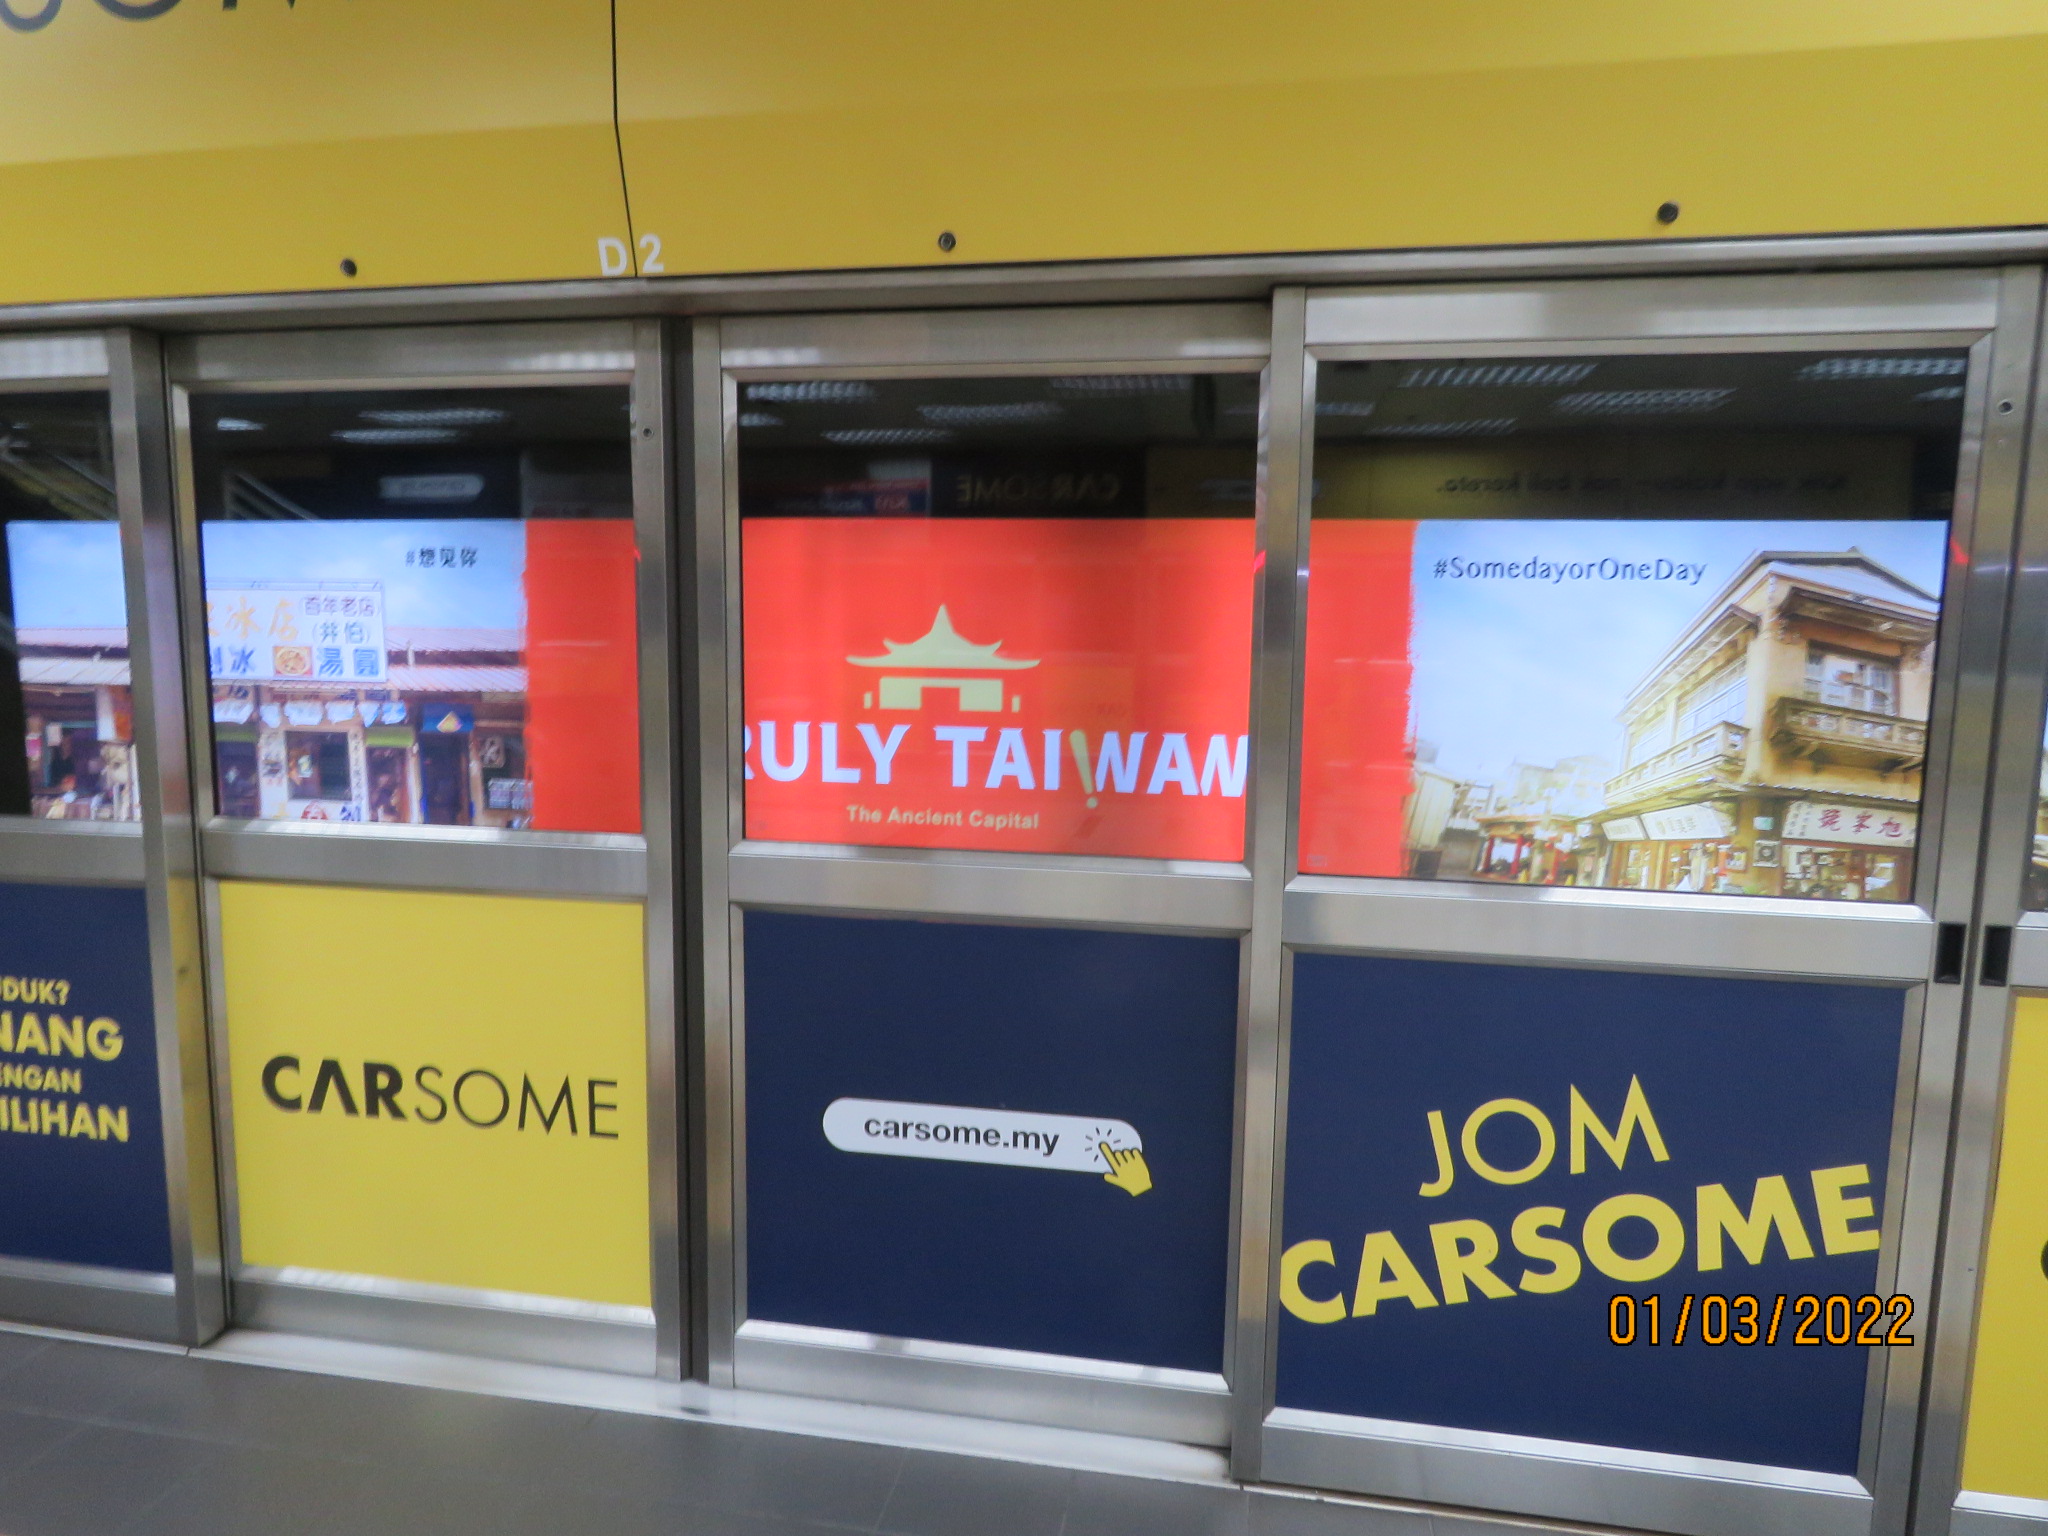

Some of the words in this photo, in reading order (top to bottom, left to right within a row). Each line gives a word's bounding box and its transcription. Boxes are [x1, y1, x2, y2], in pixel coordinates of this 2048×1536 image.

[1433, 555, 1707, 586] #SomedayorOneDay
[846, 805, 882, 824] The
[887, 806, 963, 827] Ancient
[969, 810, 1040, 831] Capital
[0, 975, 71, 1006] DUK?
[262, 1055, 619, 1140] CARSOME
[863, 1117, 1060, 1157] carsome.my
[1418, 1073, 1670, 1197] JOM
[1279, 1163, 1880, 1324] CARSOME
